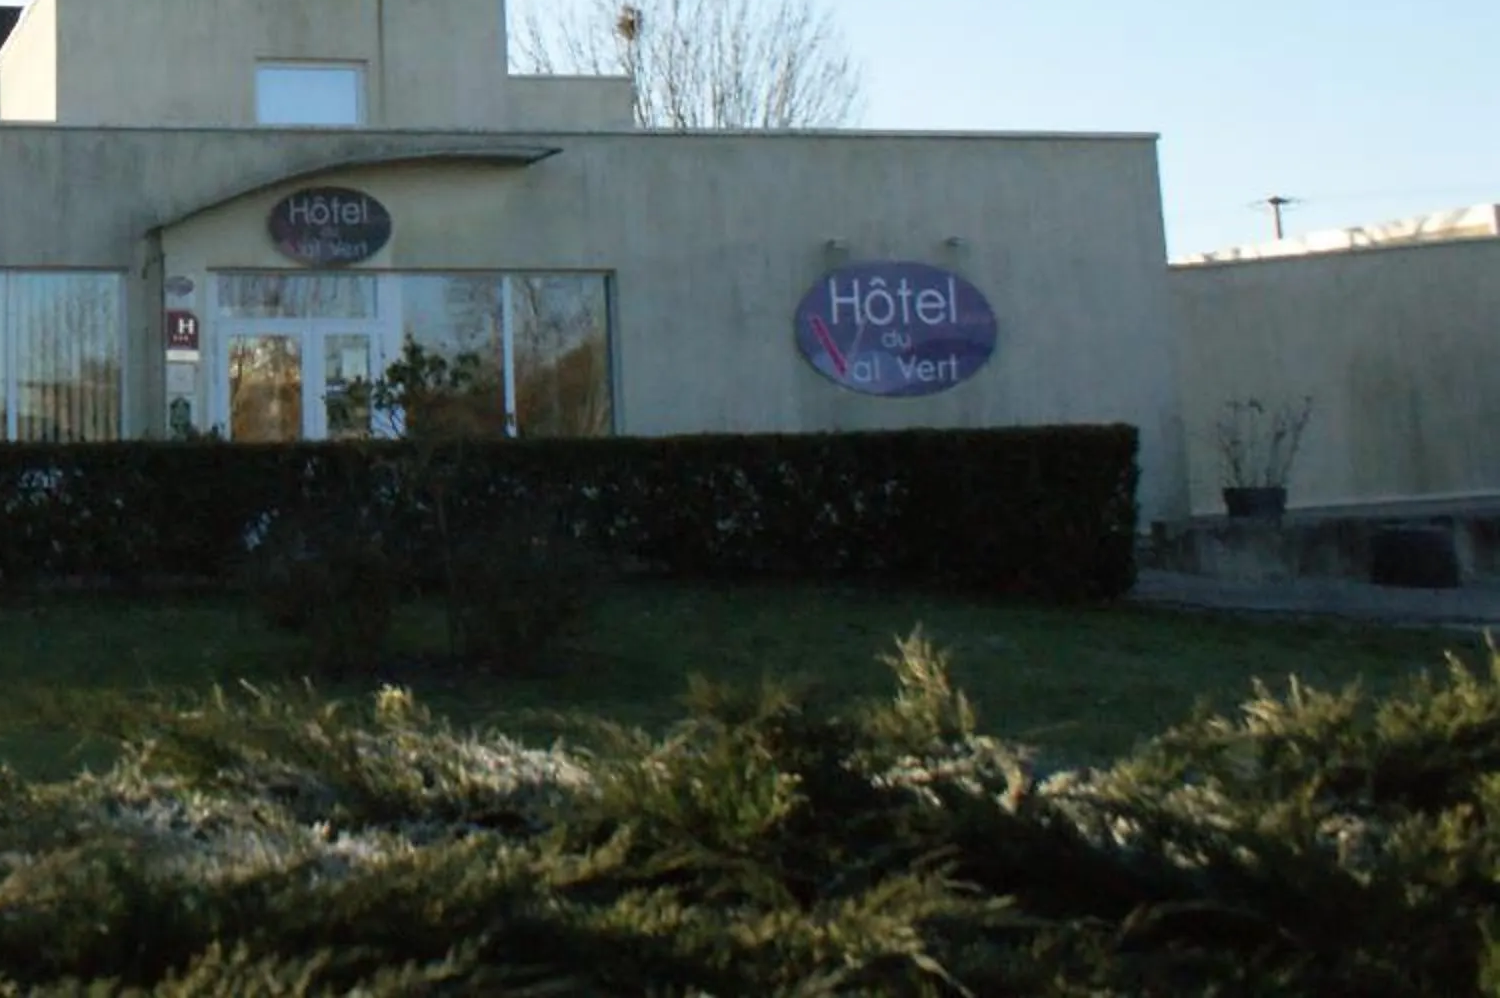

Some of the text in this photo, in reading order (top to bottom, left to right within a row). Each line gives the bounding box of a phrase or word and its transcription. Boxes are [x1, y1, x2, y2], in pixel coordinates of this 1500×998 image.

[289, 195, 368, 225] Hôtel
[828, 276, 958, 325] Hôtel
[177, 317, 195, 334] H
[880, 328, 912, 348] du
[896, 354, 960, 382] Vert
